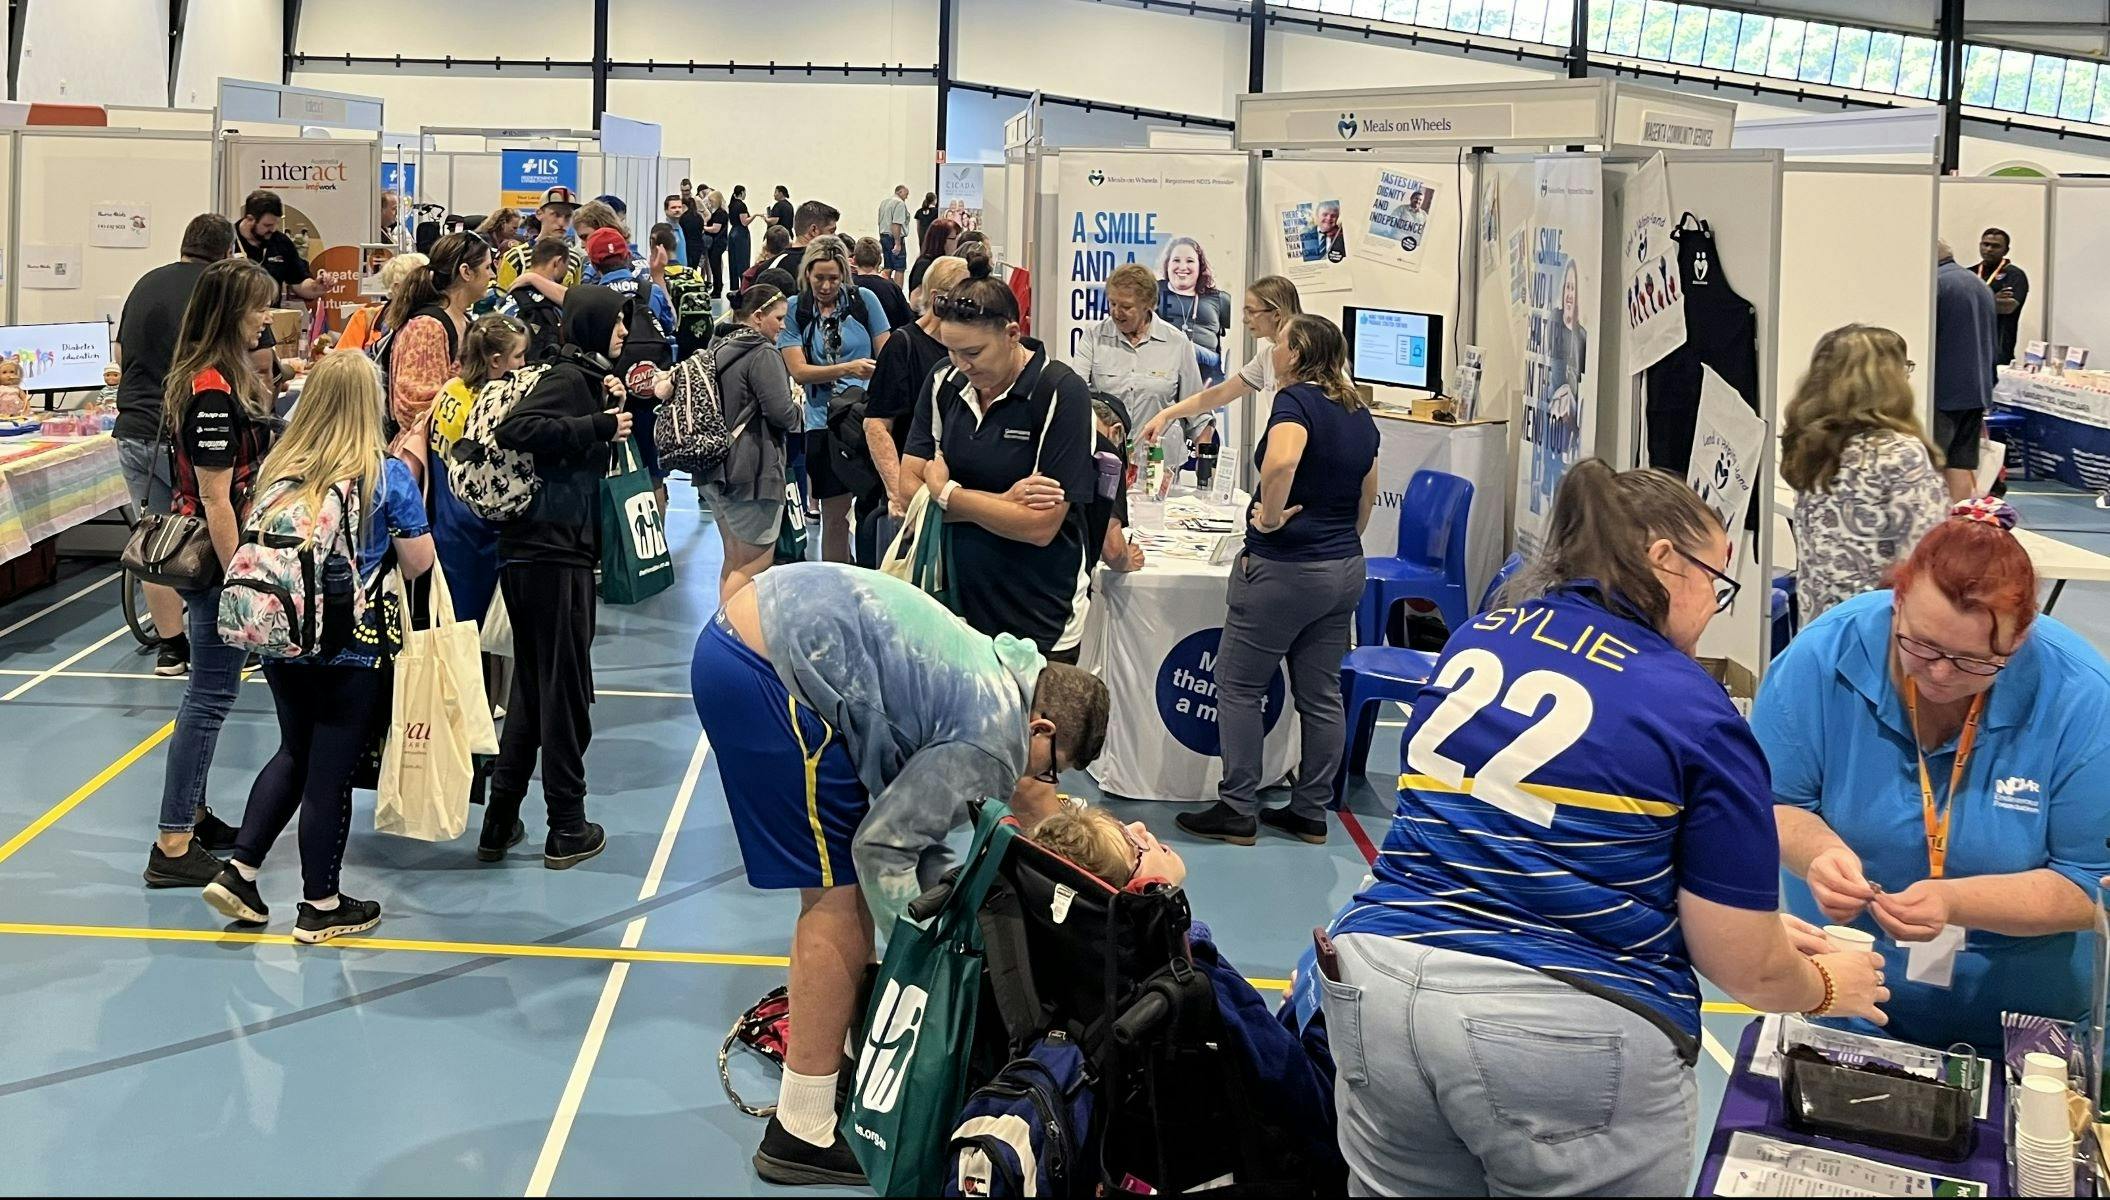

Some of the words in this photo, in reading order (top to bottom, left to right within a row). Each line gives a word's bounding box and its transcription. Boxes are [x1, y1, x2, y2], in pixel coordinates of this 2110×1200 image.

[1362, 119, 1394, 132] Meals
[1396, 122, 1410, 132] on
[1411, 118, 1452, 131] Wheels
[260, 159, 348, 182] interact
[538, 158, 558, 174] ILS
[1373, 198, 1390, 210] AND
[1072, 212, 1086, 244] A
[1094, 212, 1158, 245] SMILE
[1538, 227, 1563, 267] SMILE
[1072, 250, 1116, 282] AND
[1071, 288, 1111, 320] CHA
[62, 344, 95, 352] Diabetes
[1546, 412, 1563, 454] TOO
[1472, 607, 1638, 672] SYLIE
[1176, 697, 1190, 714] a
[1406, 648, 1594, 830] 22
